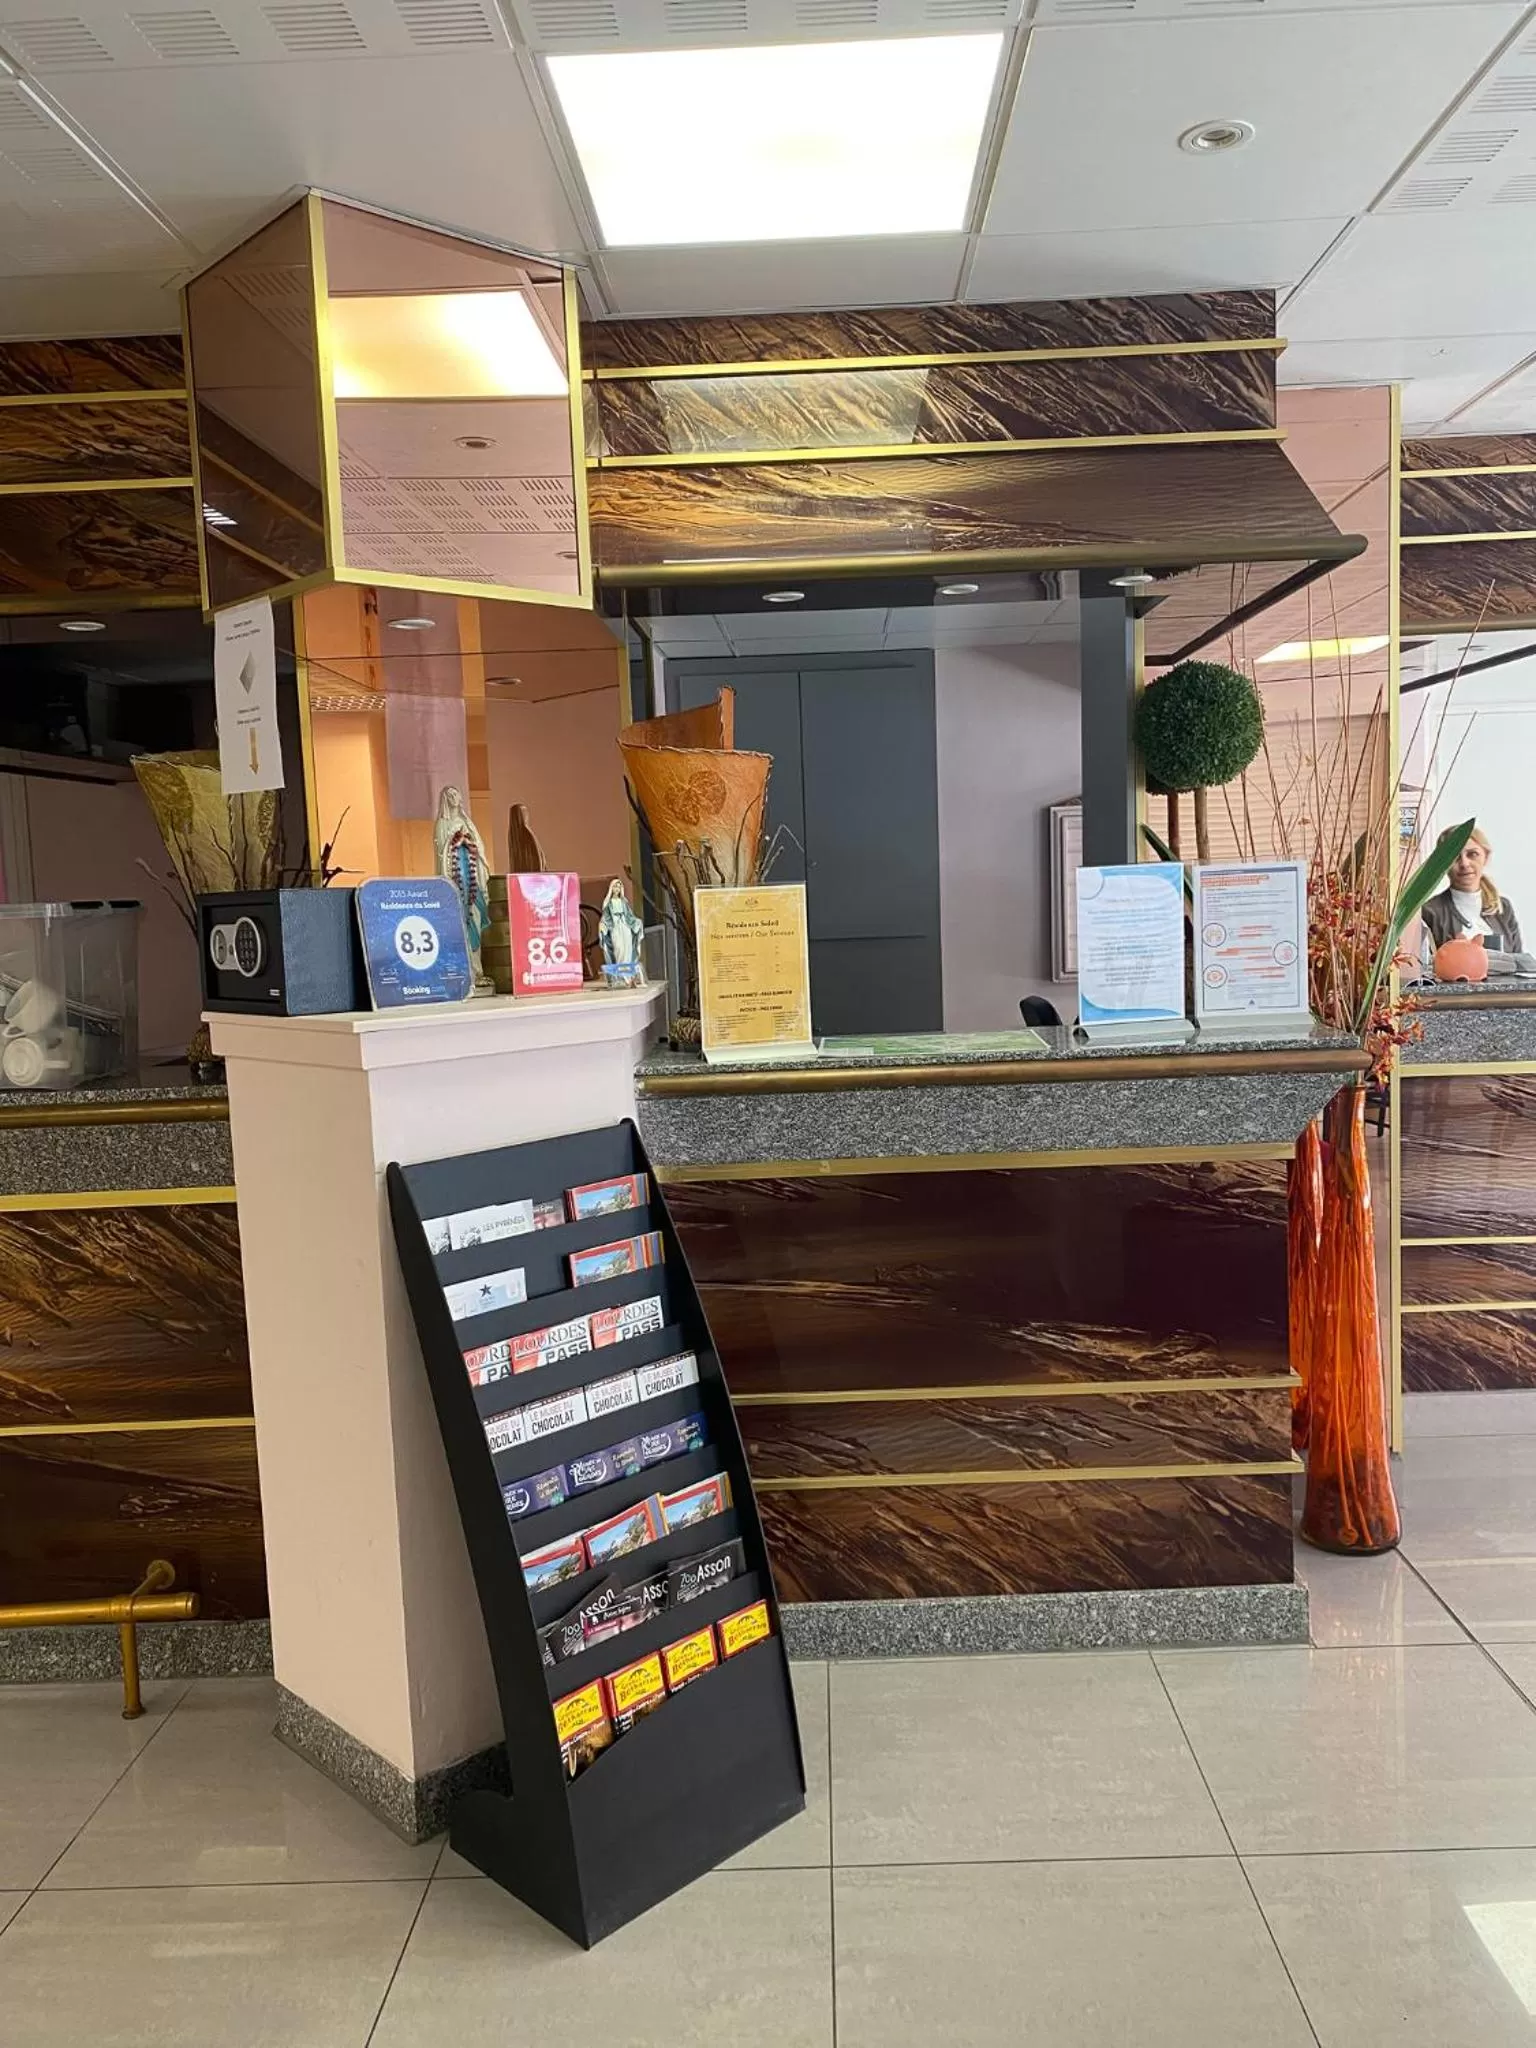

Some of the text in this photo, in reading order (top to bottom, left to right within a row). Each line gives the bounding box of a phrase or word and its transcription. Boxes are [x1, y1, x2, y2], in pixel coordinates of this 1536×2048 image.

[400, 931, 434, 955] 8,3
[595, 1300, 659, 1327] LOURDES
[514, 1321, 587, 1355] LOURDES
[621, 1317, 661, 1340] PASS
[466, 1343, 512, 1368] OURD
[545, 1340, 589, 1365] PASS
[487, 1363, 512, 1383] PA
[645, 1372, 684, 1396] CHOCOLAT
[593, 1389, 634, 1414] CHOCOLAT
[531, 1409, 575, 1436] CHOCOLAT
[490, 1427, 523, 1450] OCOLAT
[697, 1555, 732, 1583] Asson
[642, 1580, 669, 1606] Asso
[561, 1623, 581, 1643] Zoo
